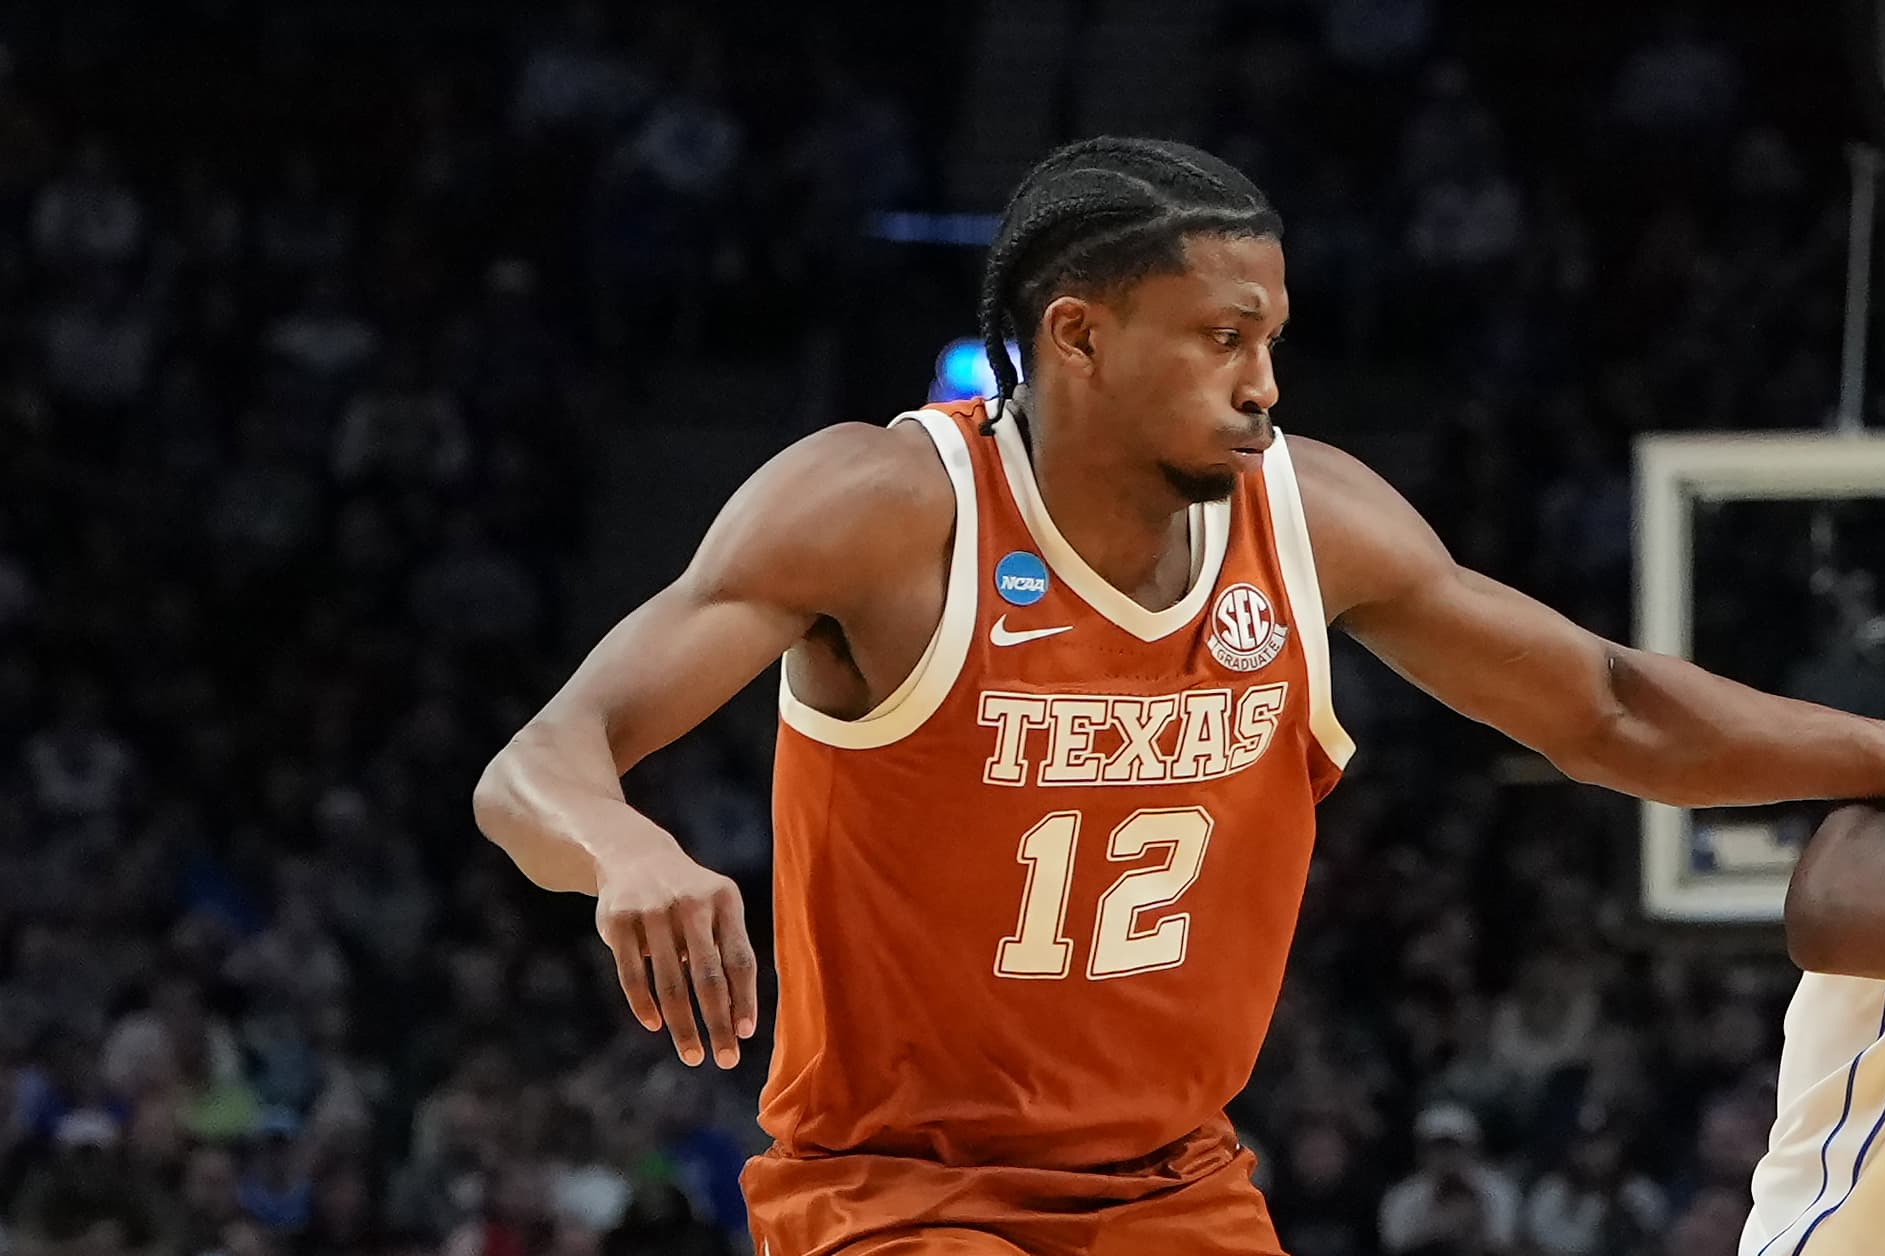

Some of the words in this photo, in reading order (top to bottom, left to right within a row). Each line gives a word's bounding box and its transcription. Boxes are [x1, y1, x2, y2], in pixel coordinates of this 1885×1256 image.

[1001, 575, 1046, 593] NCAA
[1217, 589, 1270, 650] SEC
[1216, 640, 1280, 671] GRADUATE
[978, 681, 1290, 787] TEXAS
[993, 805, 1215, 981] 12
